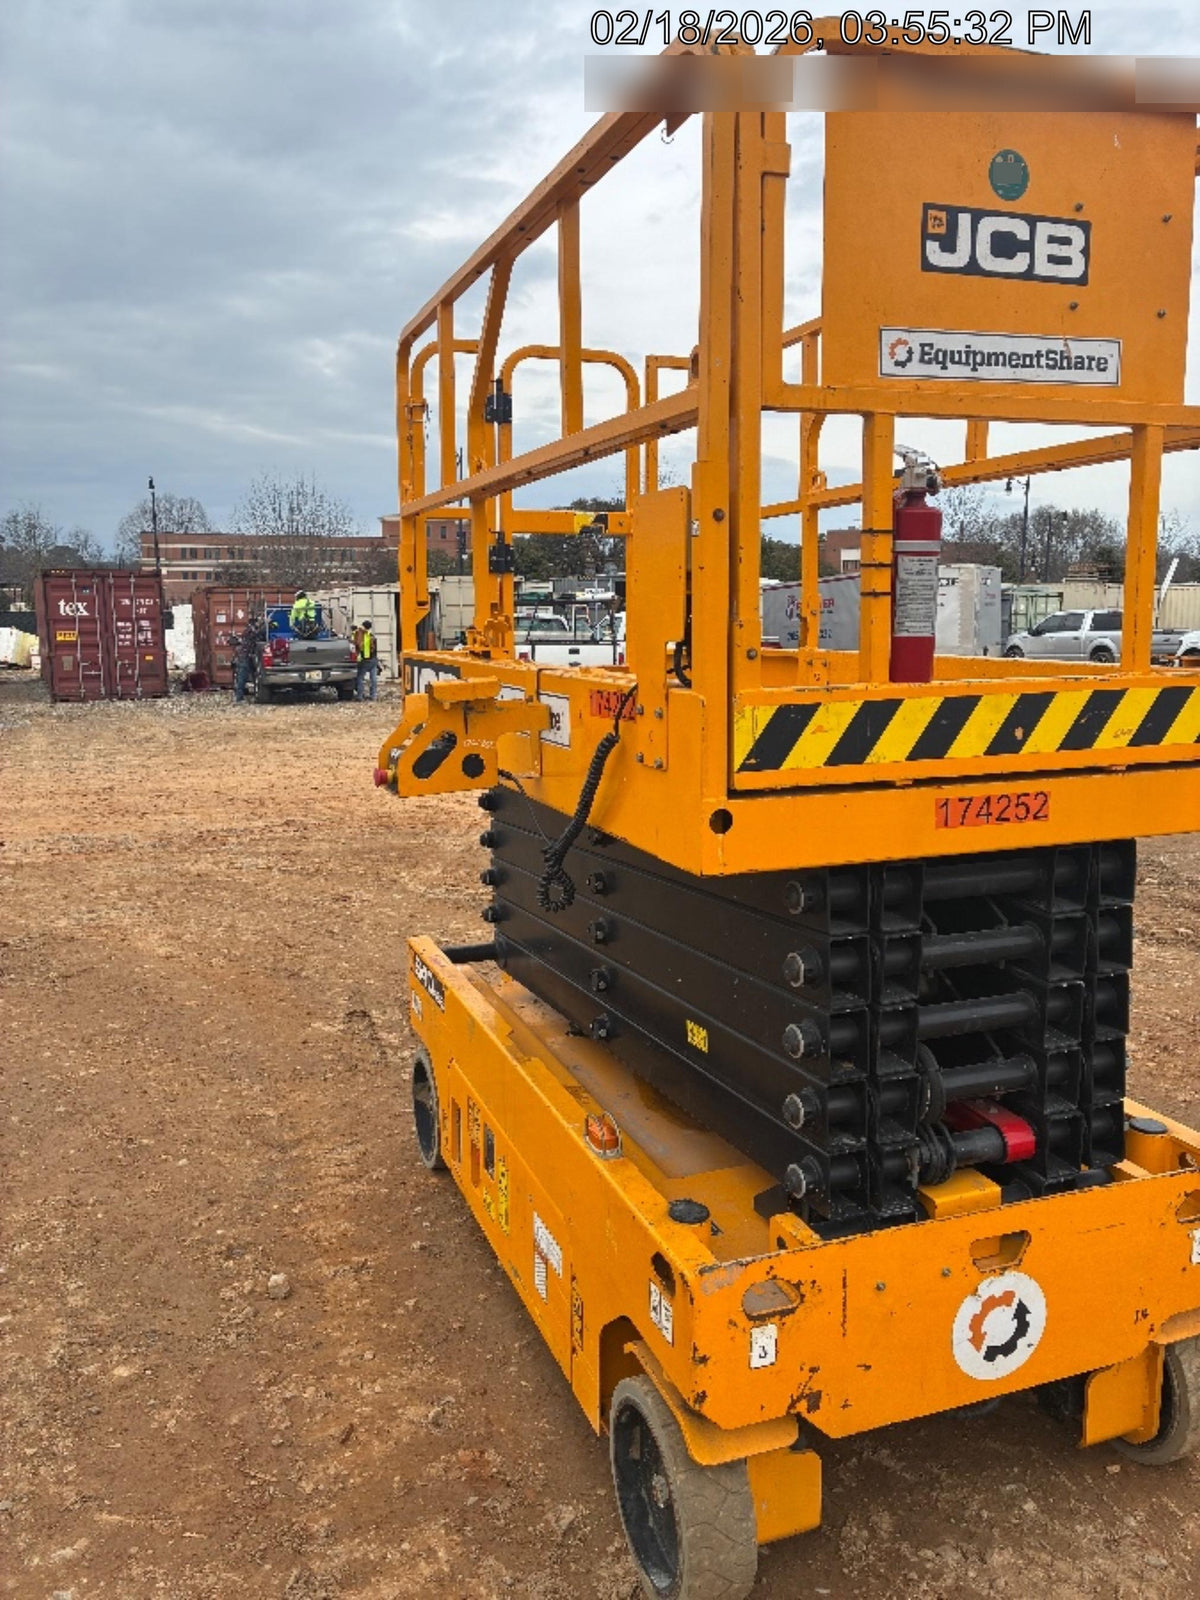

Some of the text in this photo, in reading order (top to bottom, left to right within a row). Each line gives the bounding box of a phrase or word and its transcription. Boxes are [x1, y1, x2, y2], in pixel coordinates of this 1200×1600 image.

[925, 212, 1086, 279] JCB
[918, 342, 1109, 373] EquipmentShare
[938, 790, 1049, 827] 174252
